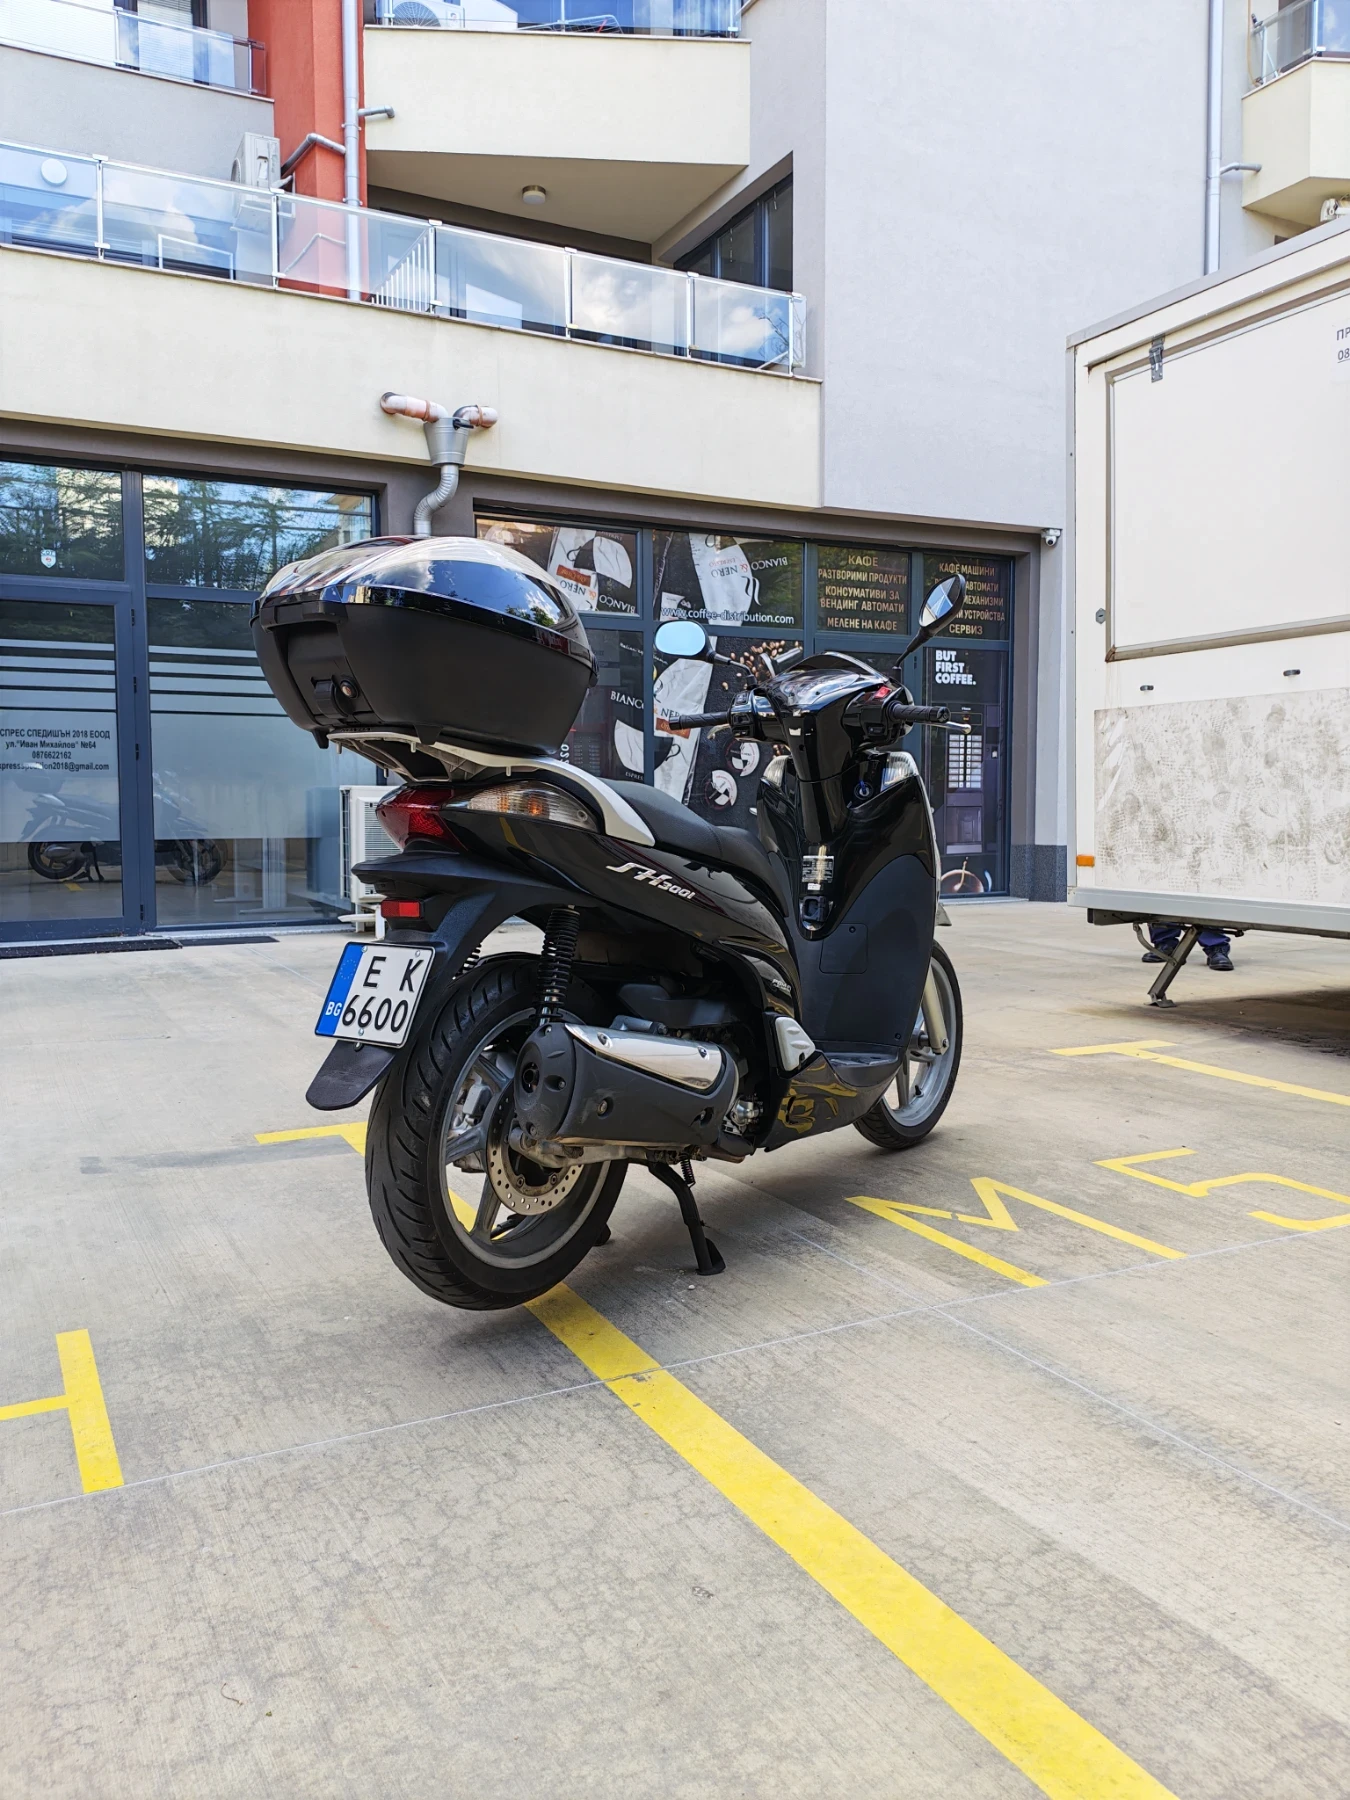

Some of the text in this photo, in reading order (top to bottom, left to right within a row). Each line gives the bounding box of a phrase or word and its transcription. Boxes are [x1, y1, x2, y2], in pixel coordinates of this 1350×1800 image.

[751, 556, 788, 571] BIANCO
[848, 555, 879, 567] КАФЕ
[711, 565, 738, 578] NERO
[818, 568, 907, 584] РАЗТВОРИМИ ПРОДУКТИ
[939, 562, 995, 576] КАФЕ МАШИНИ
[560, 580, 586, 596] NERO
[966, 580, 999, 592] АВТОМАТИ
[825, 586, 900, 601] КОНСУМАТИВИ ЗА
[599, 595, 636, 614] BIANCO
[820, 598, 905, 613] ВЕНДИНГ АВТОМАТИ
[661, 606, 795, 625] www.coffee-distribution.com
[964, 608, 1005, 621] УСТРОЙСТВА
[827, 617, 898, 631] МЕЛЕНЕ НА КАФЕ
[949, 623, 984, 636] СЕРВИЗ
[935, 650, 957, 662] BUT
[935, 662, 965, 674] FIRST
[935, 673, 977, 686] COFFEE.
[610, 690, 644, 709] BIANC
[26, 728, 71, 739] СПЕДИШЪН
[72, 729, 89, 738] 2018
[89, 730, 111, 740] ЕООД
[80, 740, 97, 749] №64
[32, 750, 72, 760] 0876622162
[362, 955, 424, 993] E K
[325, 1001, 342, 1017] BG
[341, 994, 409, 1033] 6600
